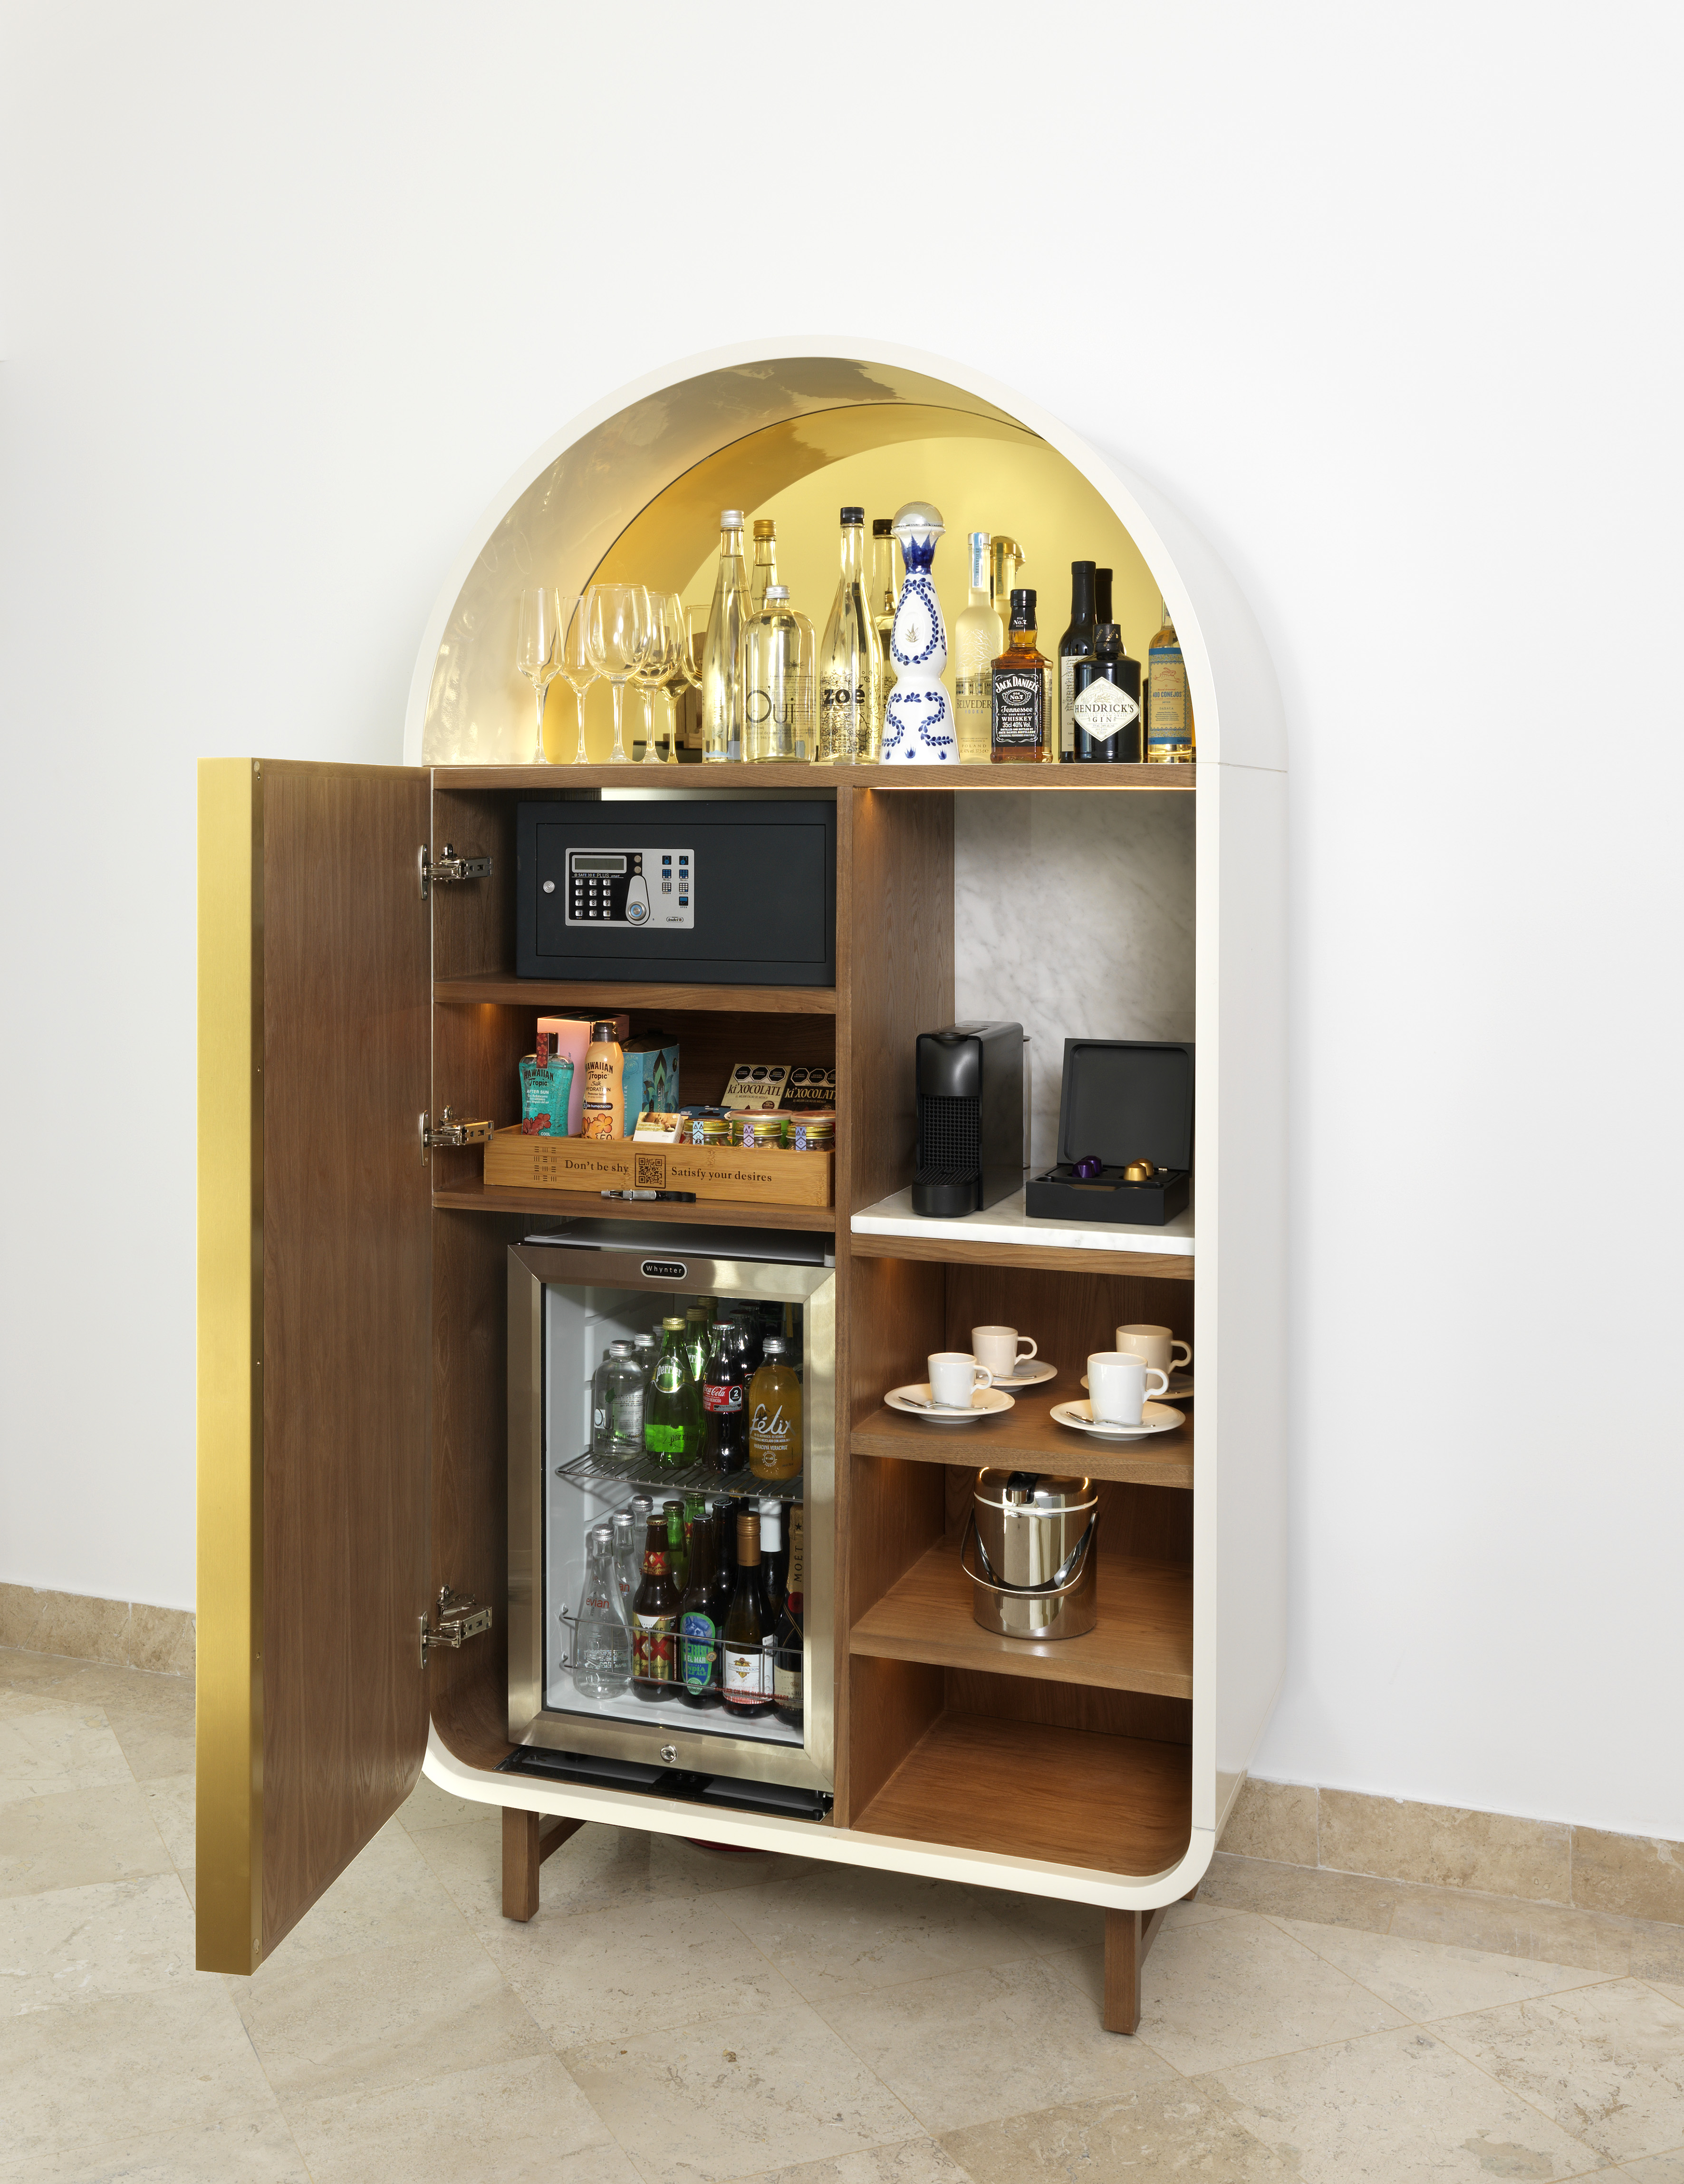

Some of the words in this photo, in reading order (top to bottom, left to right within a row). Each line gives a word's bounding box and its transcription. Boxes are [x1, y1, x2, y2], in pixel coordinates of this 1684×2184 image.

[995, 679, 1011, 693] JACK
[1012, 676, 1039, 693] DANIEL'S
[824, 684, 865, 705] zoé
[957, 699, 992, 709] BELVEDER
[1075, 704, 1135, 713] HENDRICK'S
[524, 1069, 554, 1082] HAWAIIAN
[588, 1071, 607, 1080] Tropic
[529, 1078, 548, 1087] Tropic
[565, 1160, 594, 1170] Don't
[597, 1162, 608, 1171] be
[611, 1163, 629, 1175] shy
[672, 1166, 706, 1180] Satisfy
[709, 1171, 732, 1180] your
[735, 1171, 772, 1182] desires
[646, 1265, 682, 1273] Whynter
[656, 1365, 682, 1382] perrer
[703, 1384, 727, 1397] Coca-Cola
[750, 1403, 796, 1436] félix
[794, 1545, 803, 1582] MOËT
[586, 1597, 609, 1609] evian
[767, 1693, 789, 1701] SURFACE
